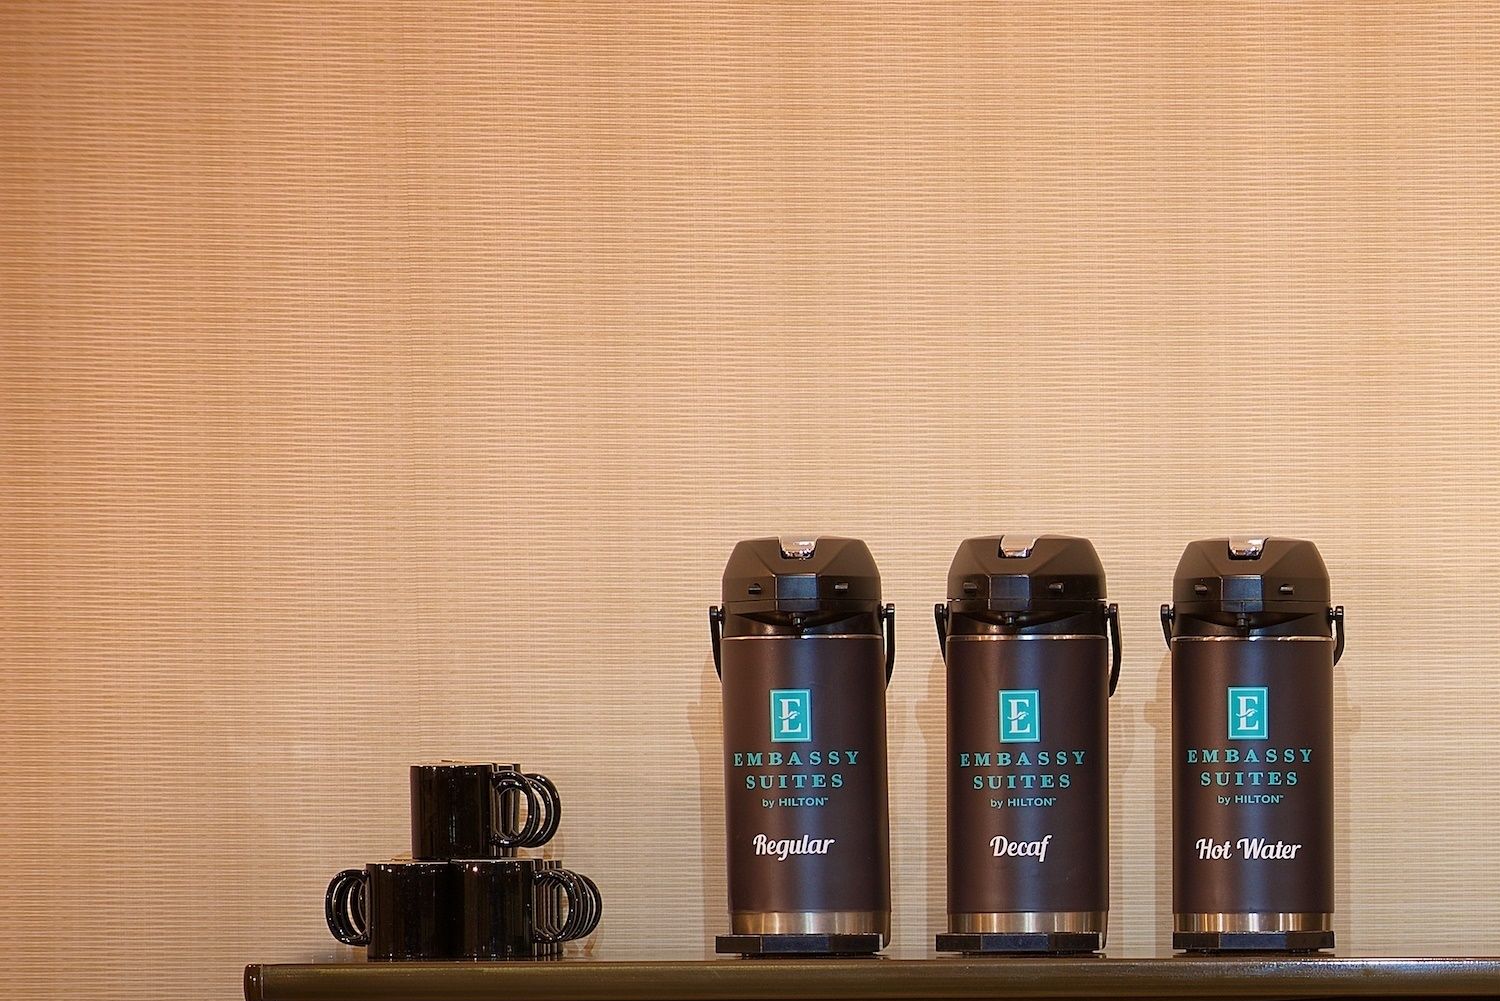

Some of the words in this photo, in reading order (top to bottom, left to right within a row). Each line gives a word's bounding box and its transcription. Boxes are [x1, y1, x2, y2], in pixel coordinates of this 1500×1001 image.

[733, 751, 859, 767] EMBASSY
[960, 751, 1085, 767] EMBASSY
[1187, 748, 1312, 763] EMBASSY
[745, 774, 843, 789] SUITES
[973, 773, 1071, 790] SUITES
[1200, 771, 1298, 786] SUITES
[762, 799, 775, 809] by
[990, 799, 1003, 809] by
[1217, 795, 1231, 806] by
[752, 833, 835, 861] Regular
[989, 835, 1053, 863] Decaf
[1195, 838, 1232, 860] Hot
[1236, 838, 1302, 860] Water
